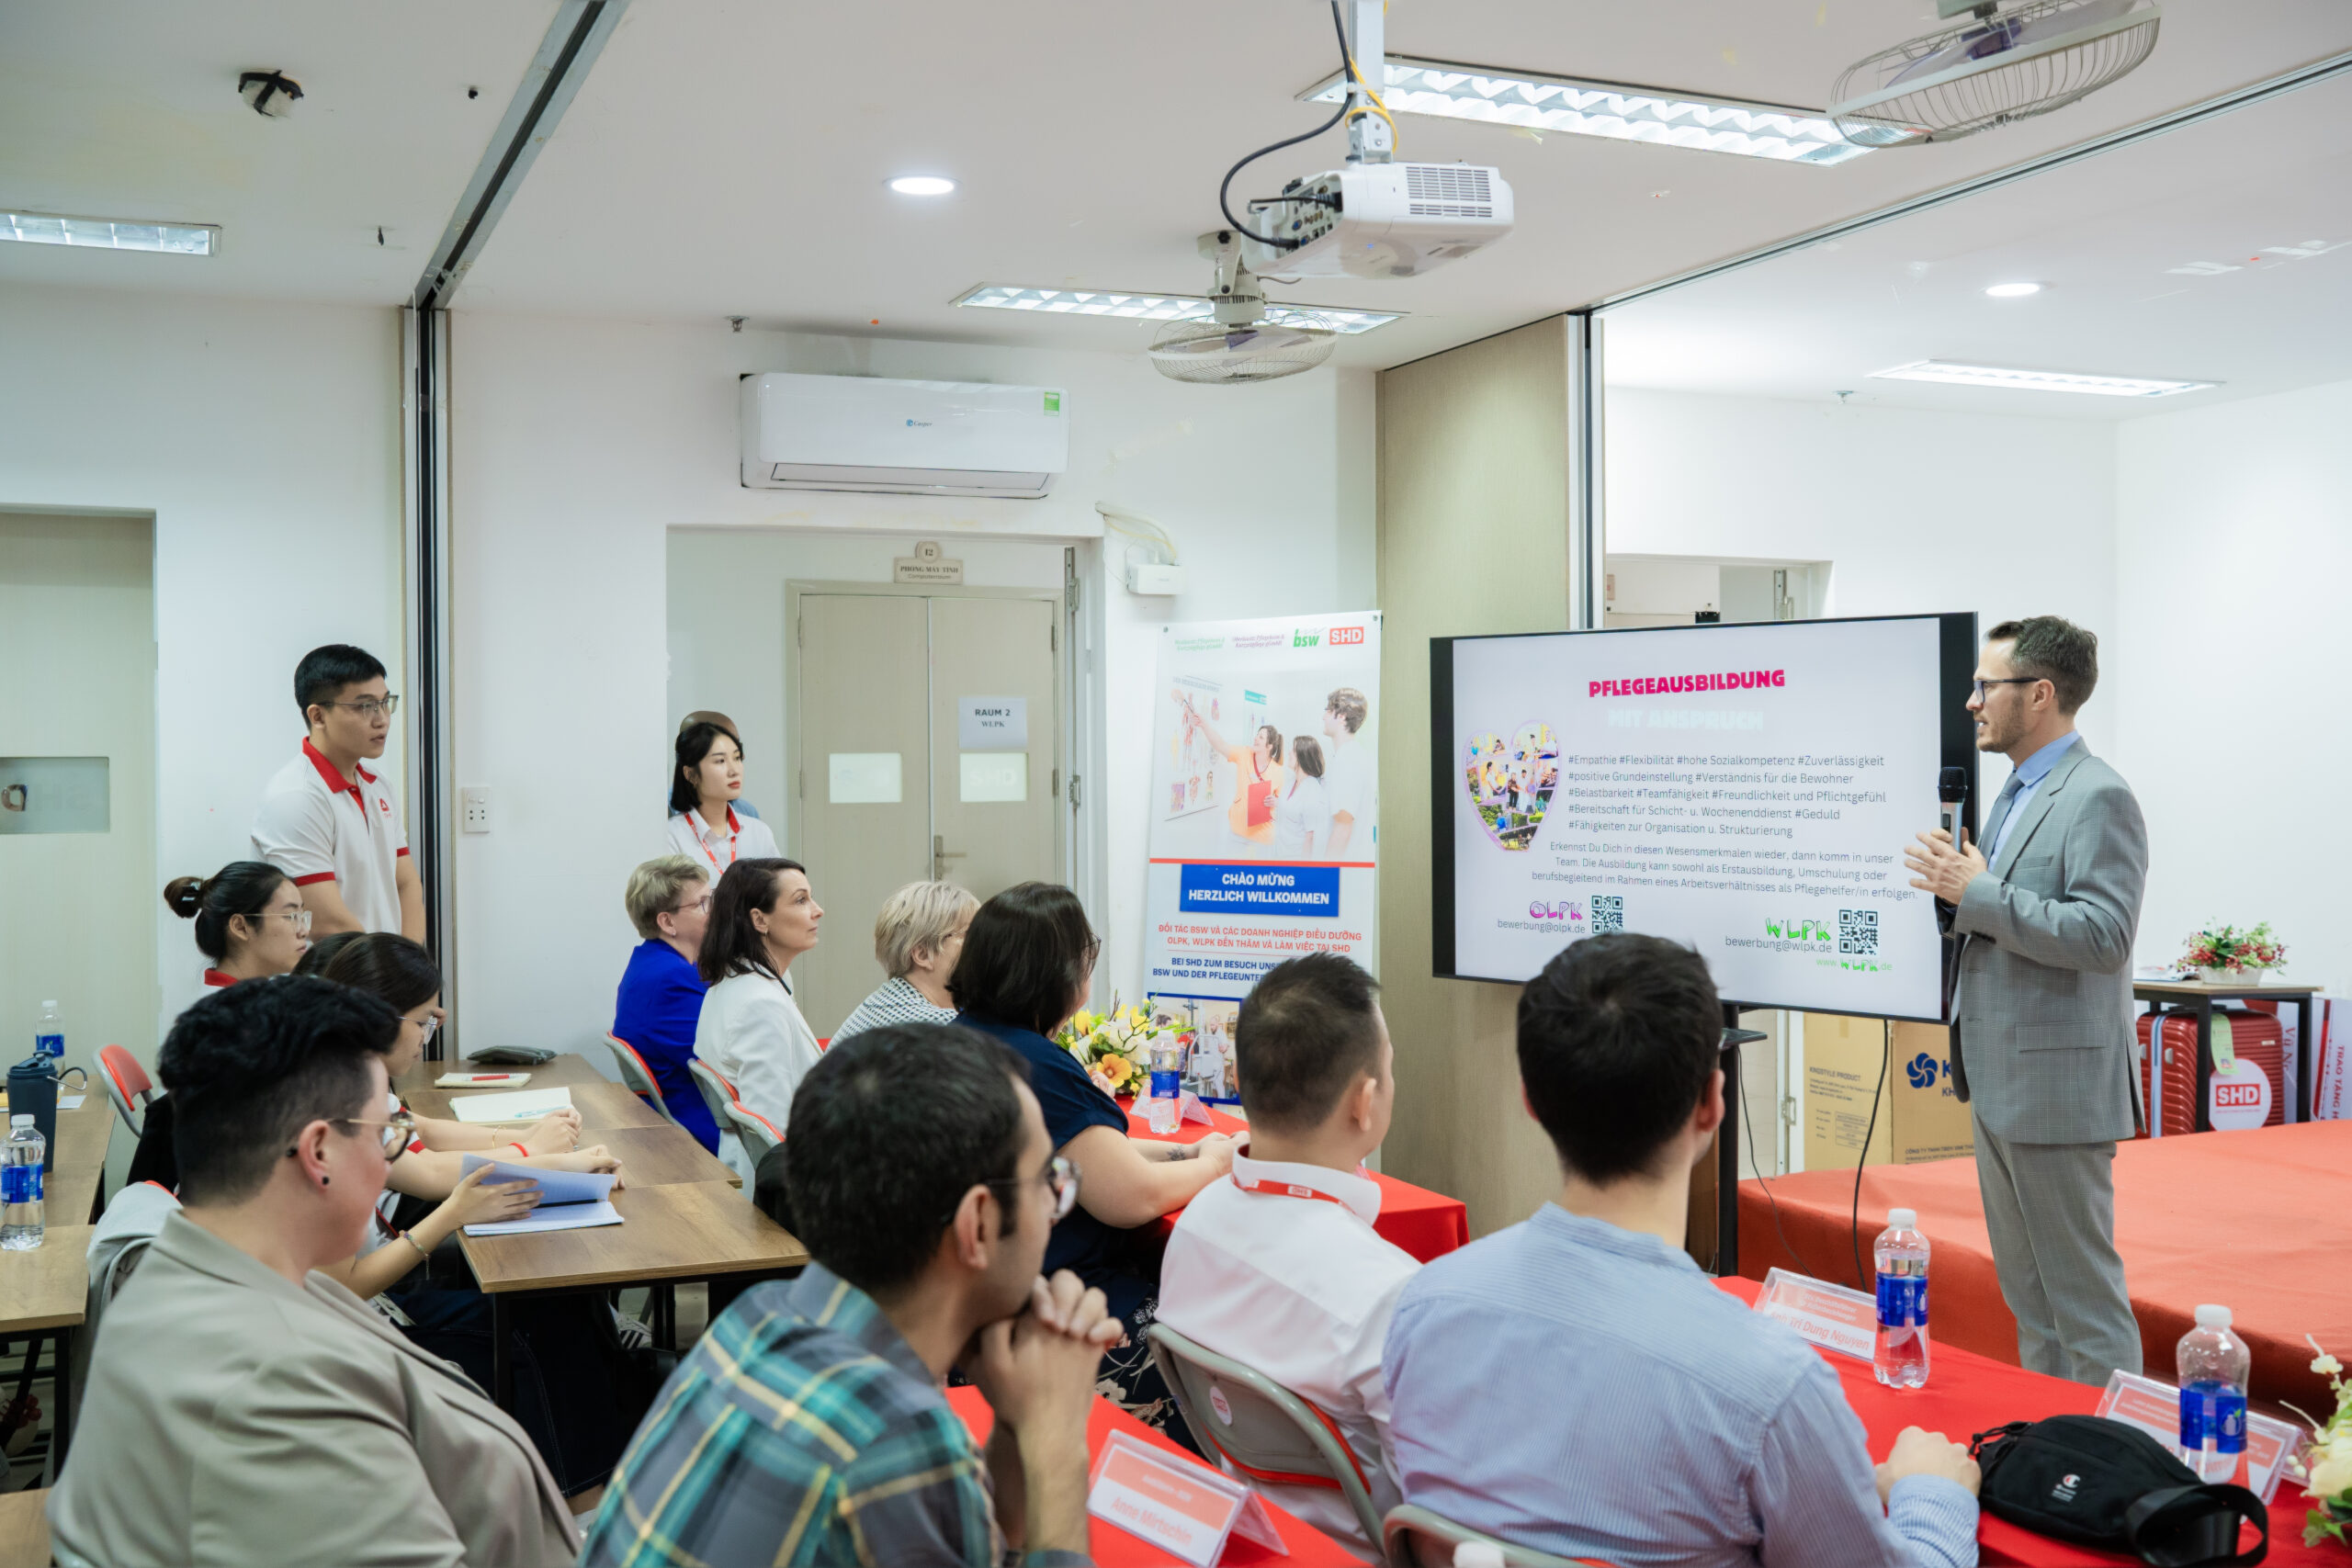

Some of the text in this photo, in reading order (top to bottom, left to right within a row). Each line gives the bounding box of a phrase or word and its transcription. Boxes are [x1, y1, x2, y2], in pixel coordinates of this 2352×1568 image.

[1294, 628, 1319, 648] bsw
[1330, 628, 1363, 645] SHD
[1589, 670, 1785, 698] PFLEGEAUSBILDUNG
[975, 708, 1011, 716] RAUM 2
[1608, 707, 1765, 732] MIT ANSPRUCH
[1568, 754, 1885, 769] #Empathie #Flexibilität #hohe Sozialkompetenz #Zuverlässigkeit
[1568, 771, 1854, 784] #positive Grundeinstellung #Verständnis für die Bewohner
[1568, 787, 1887, 805] #Belastbarkeit #Teamfähigkeit #Freundlichkeit und Pflichtgefühl
[1568, 803, 1629, 815] #Bereitschaft
[1632, 804, 1645, 815] für
[1647, 805, 1688, 816] Schicht-
[1702, 807, 1792, 818] Wochenenddienst
[1794, 808, 1840, 819] #Geduld
[1568, 820, 1793, 839] #Fähigkeiten zur Organisation u. Strukturierung
[1550, 841, 1894, 863] Erkennst Du Dich in diesen Wesensmerkmalen wieder, dann komm in unser
[1555, 857, 1888, 882] Team. Die Ausbildung kann sowohl als Erstausbildung, Umschulung oder
[1222, 872, 1295, 886] CHÀO MỪNG
[1532, 871, 1918, 901] berufsbegleitend im Rahmen eines Arbeitsverhältnisses als Pflegehelfer/in erfolgen.
[1188, 889, 1329, 905] HERZLICH WILLKOMMEN
[1529, 900, 1583, 920] OLPK
[1159, 921, 1172, 932] ĐỐI
[1174, 923, 1189, 933] TÁC
[1191, 926, 1208, 934] BSW
[1210, 924, 1221, 934] VÀ
[1223, 925, 1238, 935] CÁC
[1241, 928, 1270, 937] DOANH
[1272, 928, 1304, 940] NGHIỆP
[1329, 930, 1363, 941] DƯỠNG
[1498, 918, 1586, 934] bewerbung@olpk.de
[1765, 917, 1832, 942] WLPK
[1167, 936, 1190, 946] OLPK,
[1193, 938, 1216, 946] WLPK
[1217, 935, 1234, 947] ĐẾN
[1262, 939, 1272, 949] VÀ
[1274, 940, 1293, 950] LÀM
[1295, 942, 1315, 953] VIỆC
[1331, 944, 1351, 953] SHD
[1725, 935, 1832, 953] bewerbung@wlpk.de
[1171, 957, 1184, 965] BEI
[1186, 958, 1202, 967] SHD
[1204, 959, 1223, 968] ZUM
[1224, 960, 1257, 970] BESUCH
[1152, 967, 1170, 976] BSW
[1172, 968, 1189, 977] UND
[1191, 970, 1207, 979] DER
[1837, 1072, 1861, 1082] PRODUCT
[2217, 1086, 2259, 1105] SHD
[1803, 1321, 1830, 1340] Dung
[1830, 1329, 1870, 1351] Nguyen
[1111, 1496, 1139, 1520] Anne
